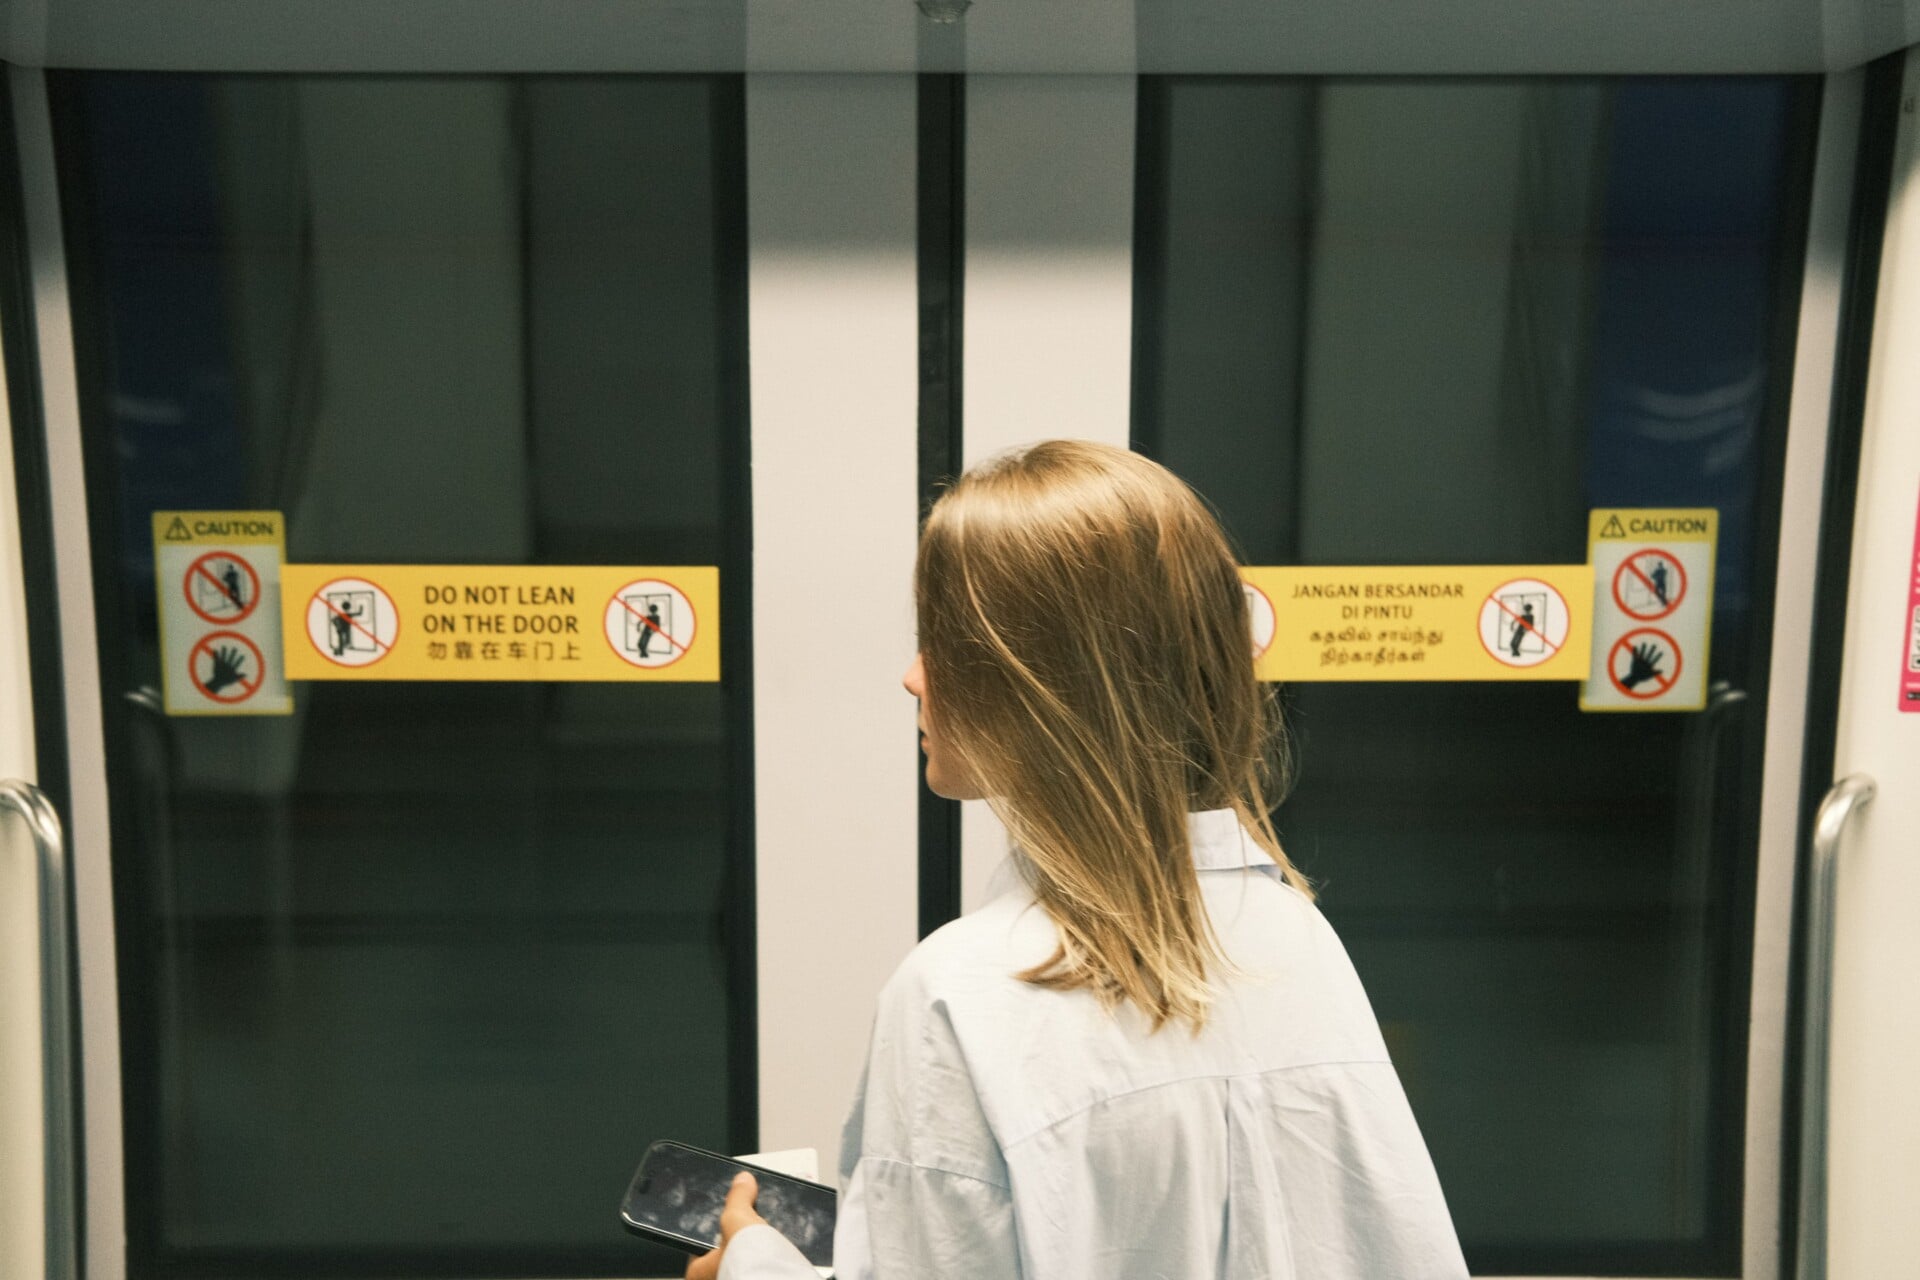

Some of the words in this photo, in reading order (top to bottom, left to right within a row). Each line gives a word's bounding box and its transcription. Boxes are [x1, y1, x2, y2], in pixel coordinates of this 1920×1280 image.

[194, 521, 273, 536] CAUTION
[1629, 519, 1707, 534] CAUTION
[424, 586, 457, 605] DO
[465, 586, 510, 605] NOT
[518, 586, 575, 605] LEAN
[1292, 584, 1360, 599] JANGAN
[1365, 584, 1464, 598] BERSANDAR
[1342, 605, 1359, 619] DI
[1364, 605, 1413, 619] PINTU
[423, 614, 456, 634] ON
[463, 614, 506, 634] THE
[514, 614, 579, 634] DOOR
[428, 641, 581, 660] 勿靠在车门上
